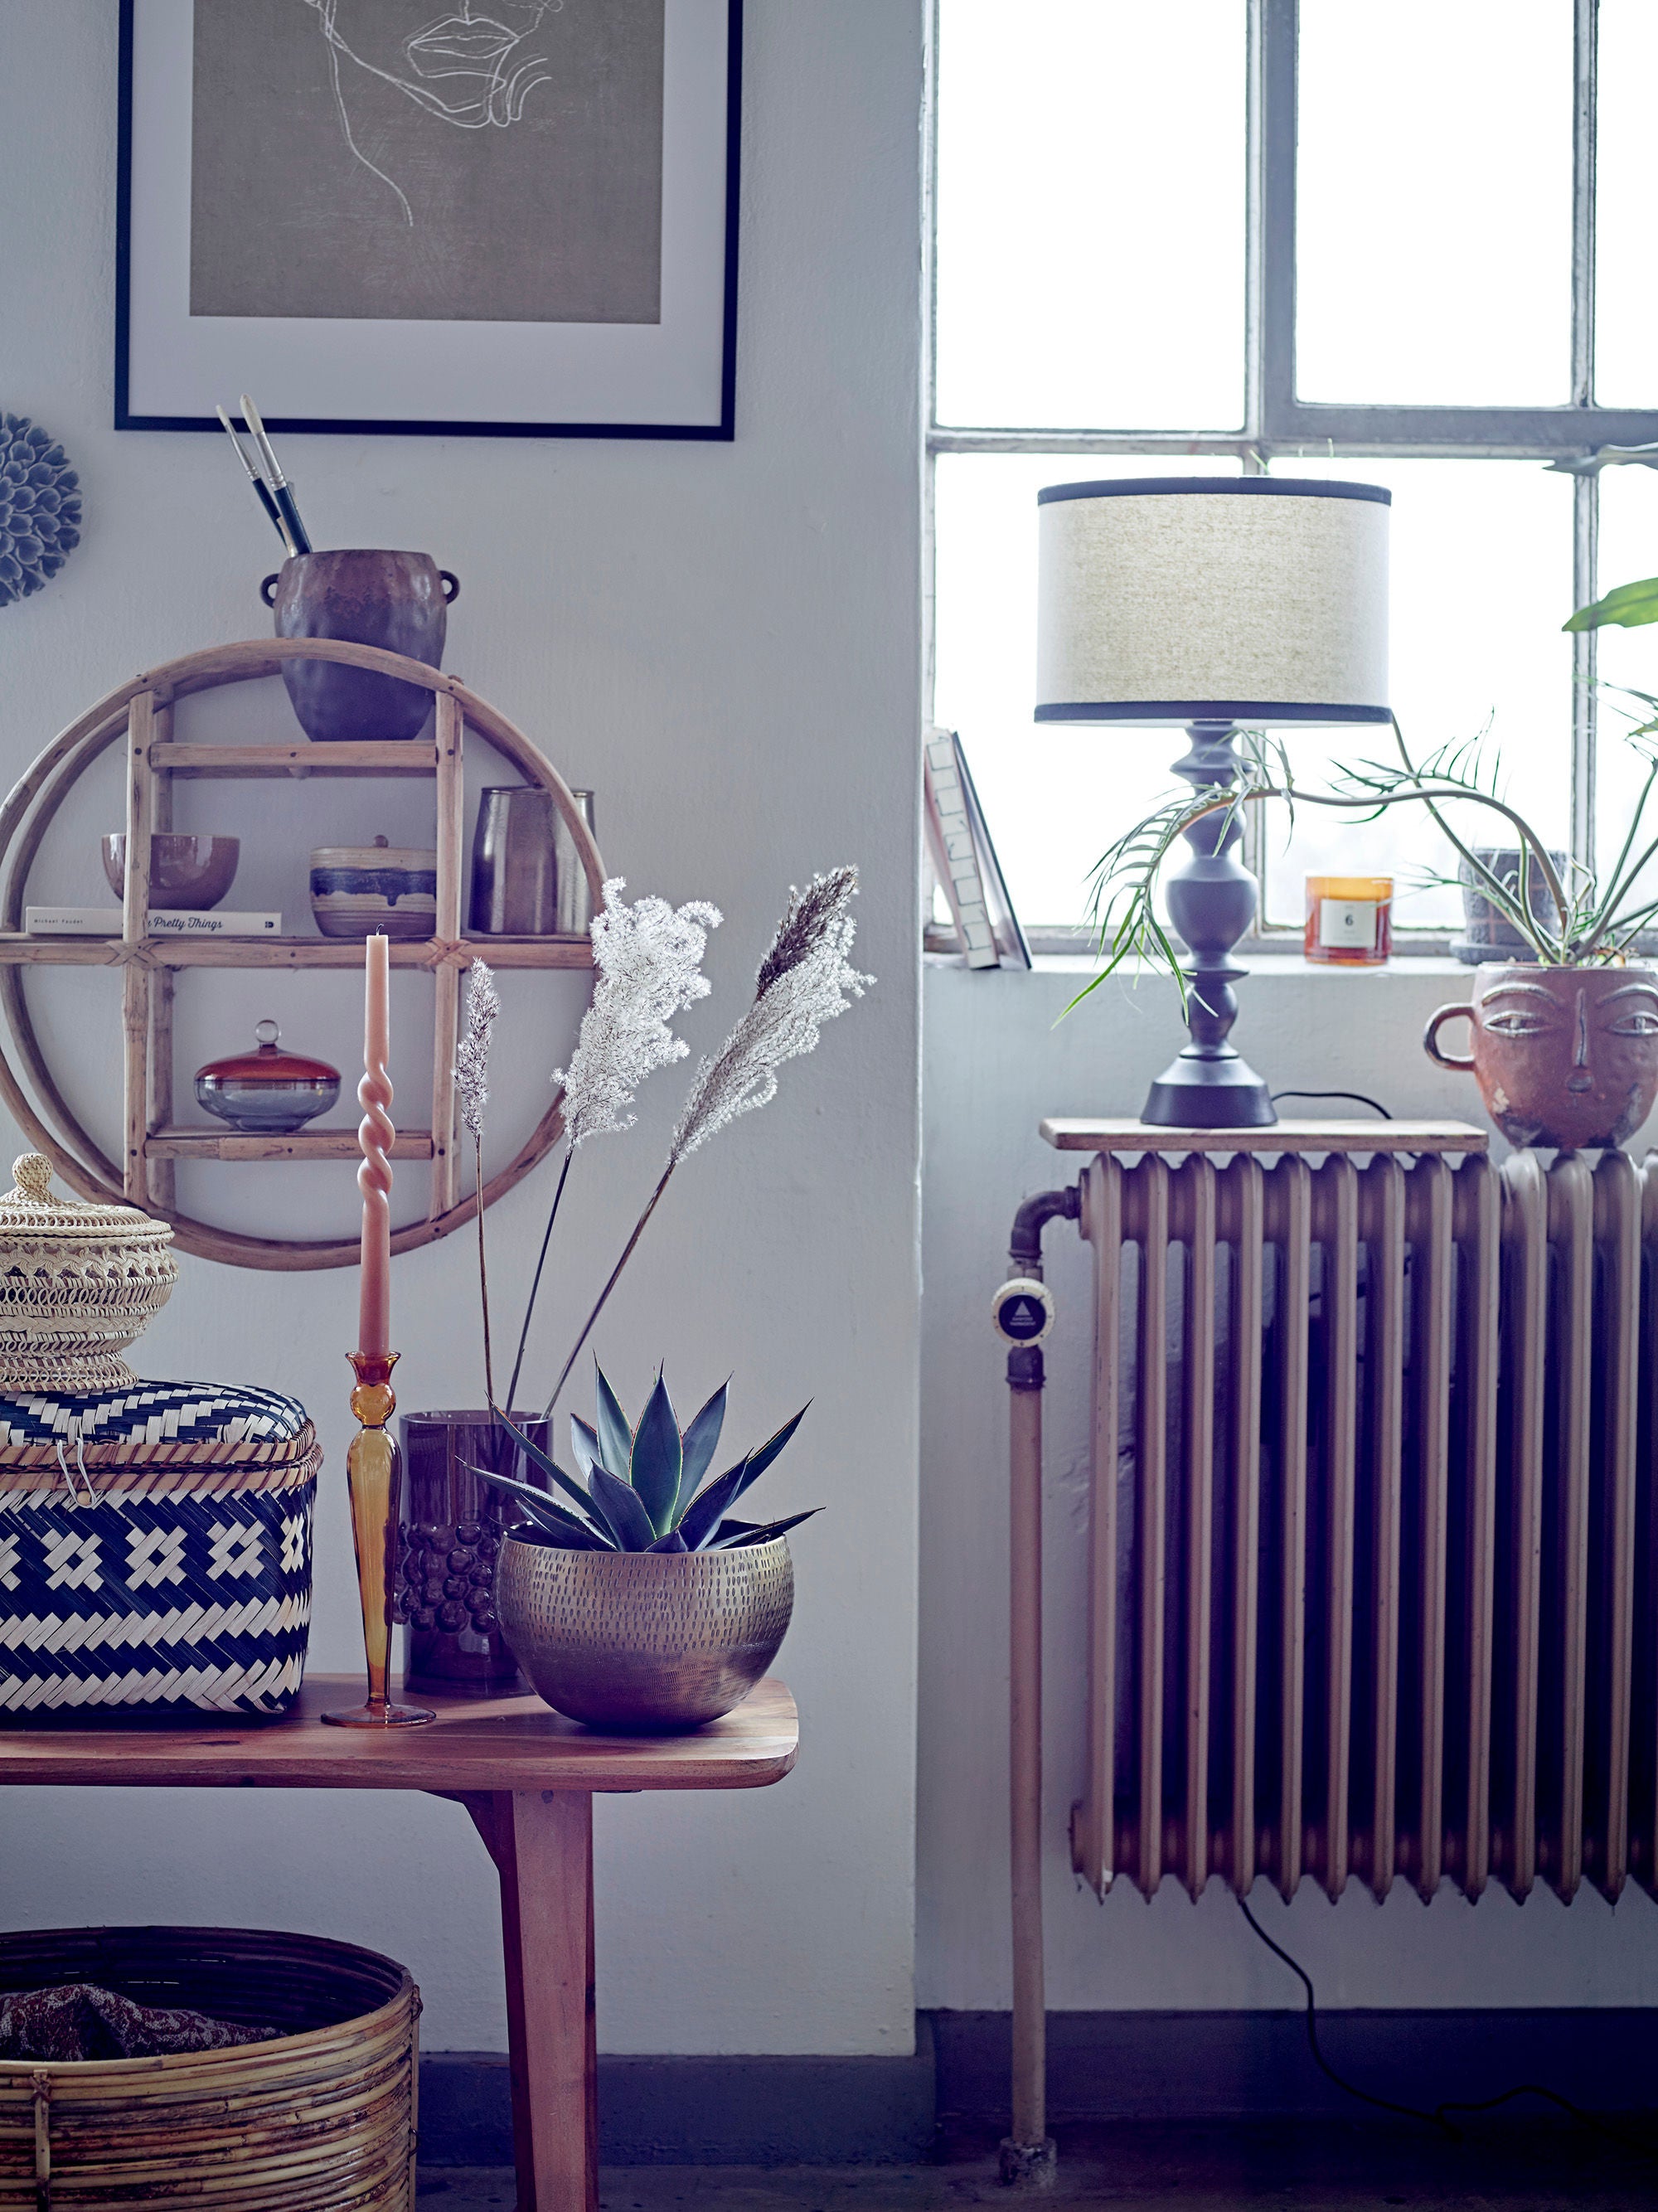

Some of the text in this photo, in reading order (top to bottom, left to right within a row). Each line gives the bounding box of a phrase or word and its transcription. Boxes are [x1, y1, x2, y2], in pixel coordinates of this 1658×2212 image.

[153, 916, 186, 931] Pretty
[187, 917, 223, 932] Things
[1345, 914, 1354, 926] 6
